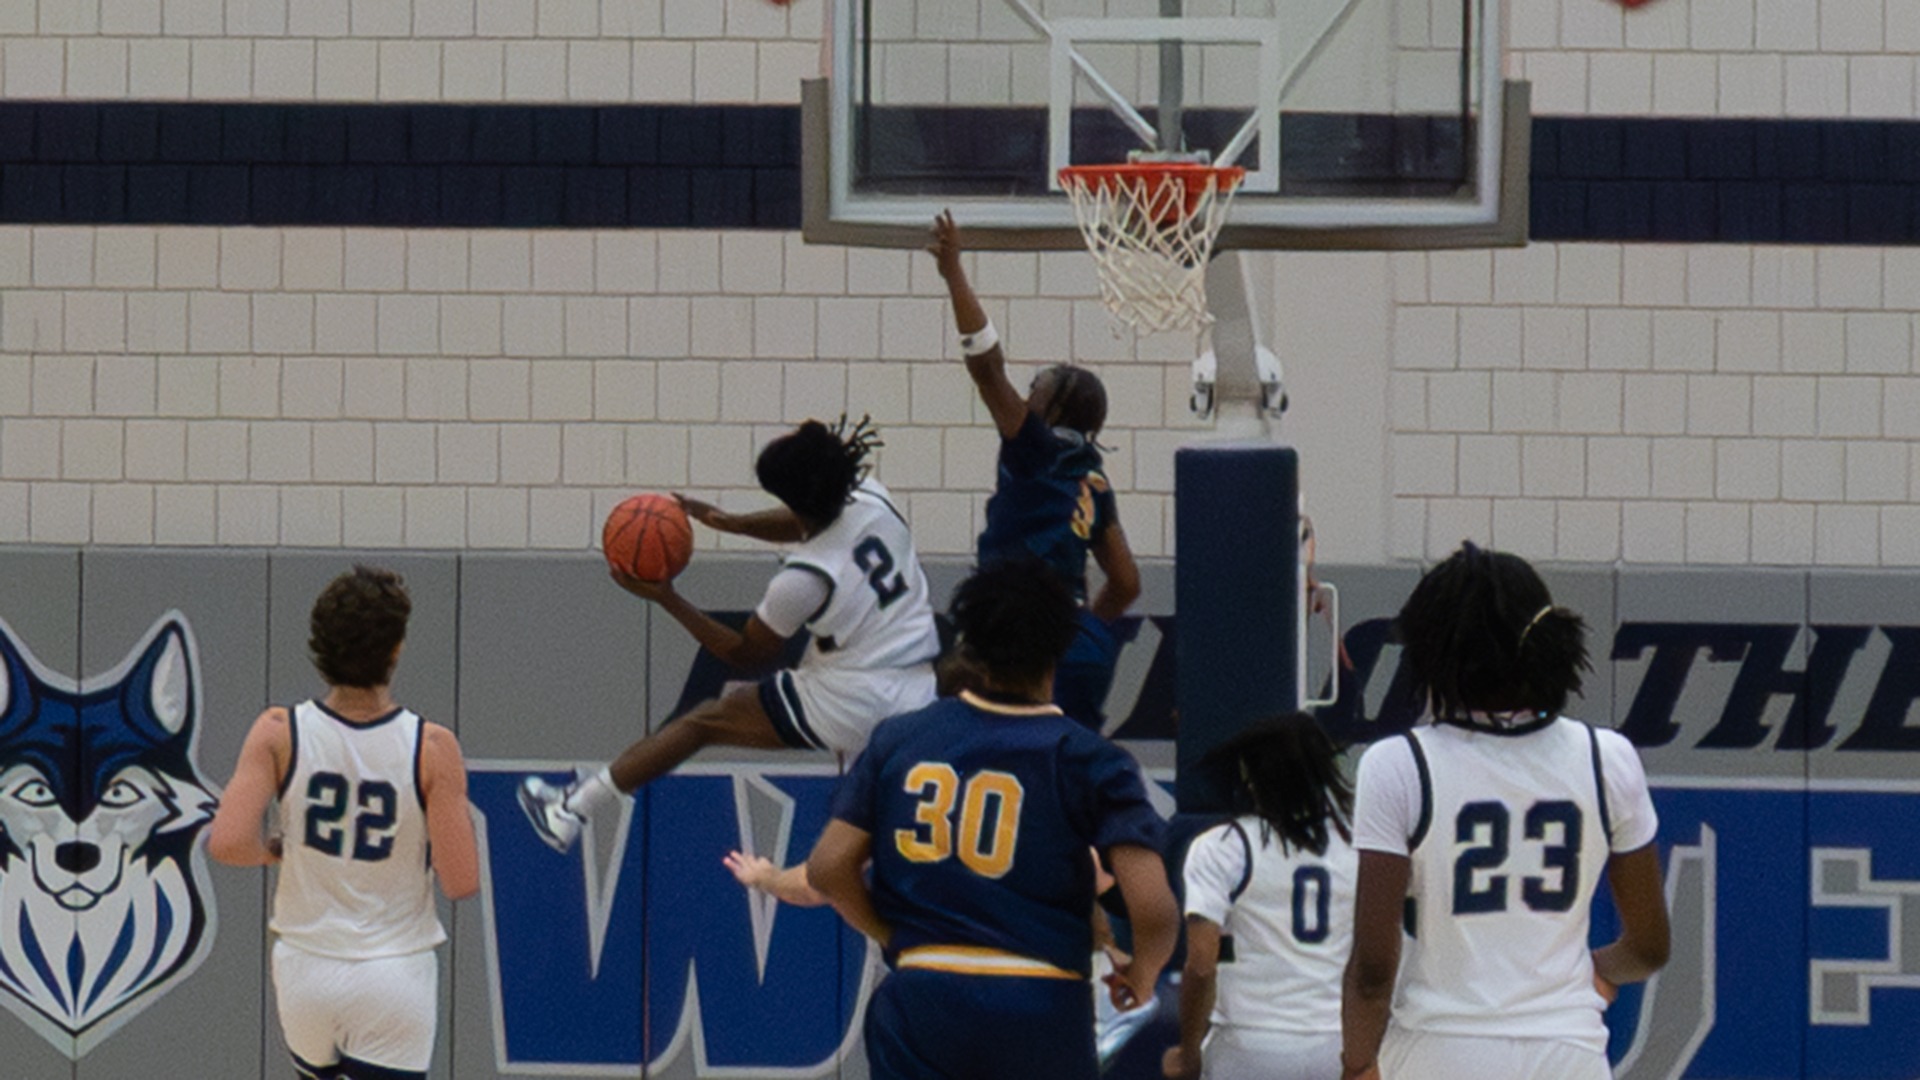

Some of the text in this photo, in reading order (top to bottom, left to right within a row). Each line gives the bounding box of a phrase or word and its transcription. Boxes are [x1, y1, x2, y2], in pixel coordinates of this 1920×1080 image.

[852, 535, 910, 611] 2
[304, 770, 398, 862] 22
[894, 761, 1025, 880] 30
[1452, 799, 1583, 915] 23
[1291, 864, 1332, 944] 0
